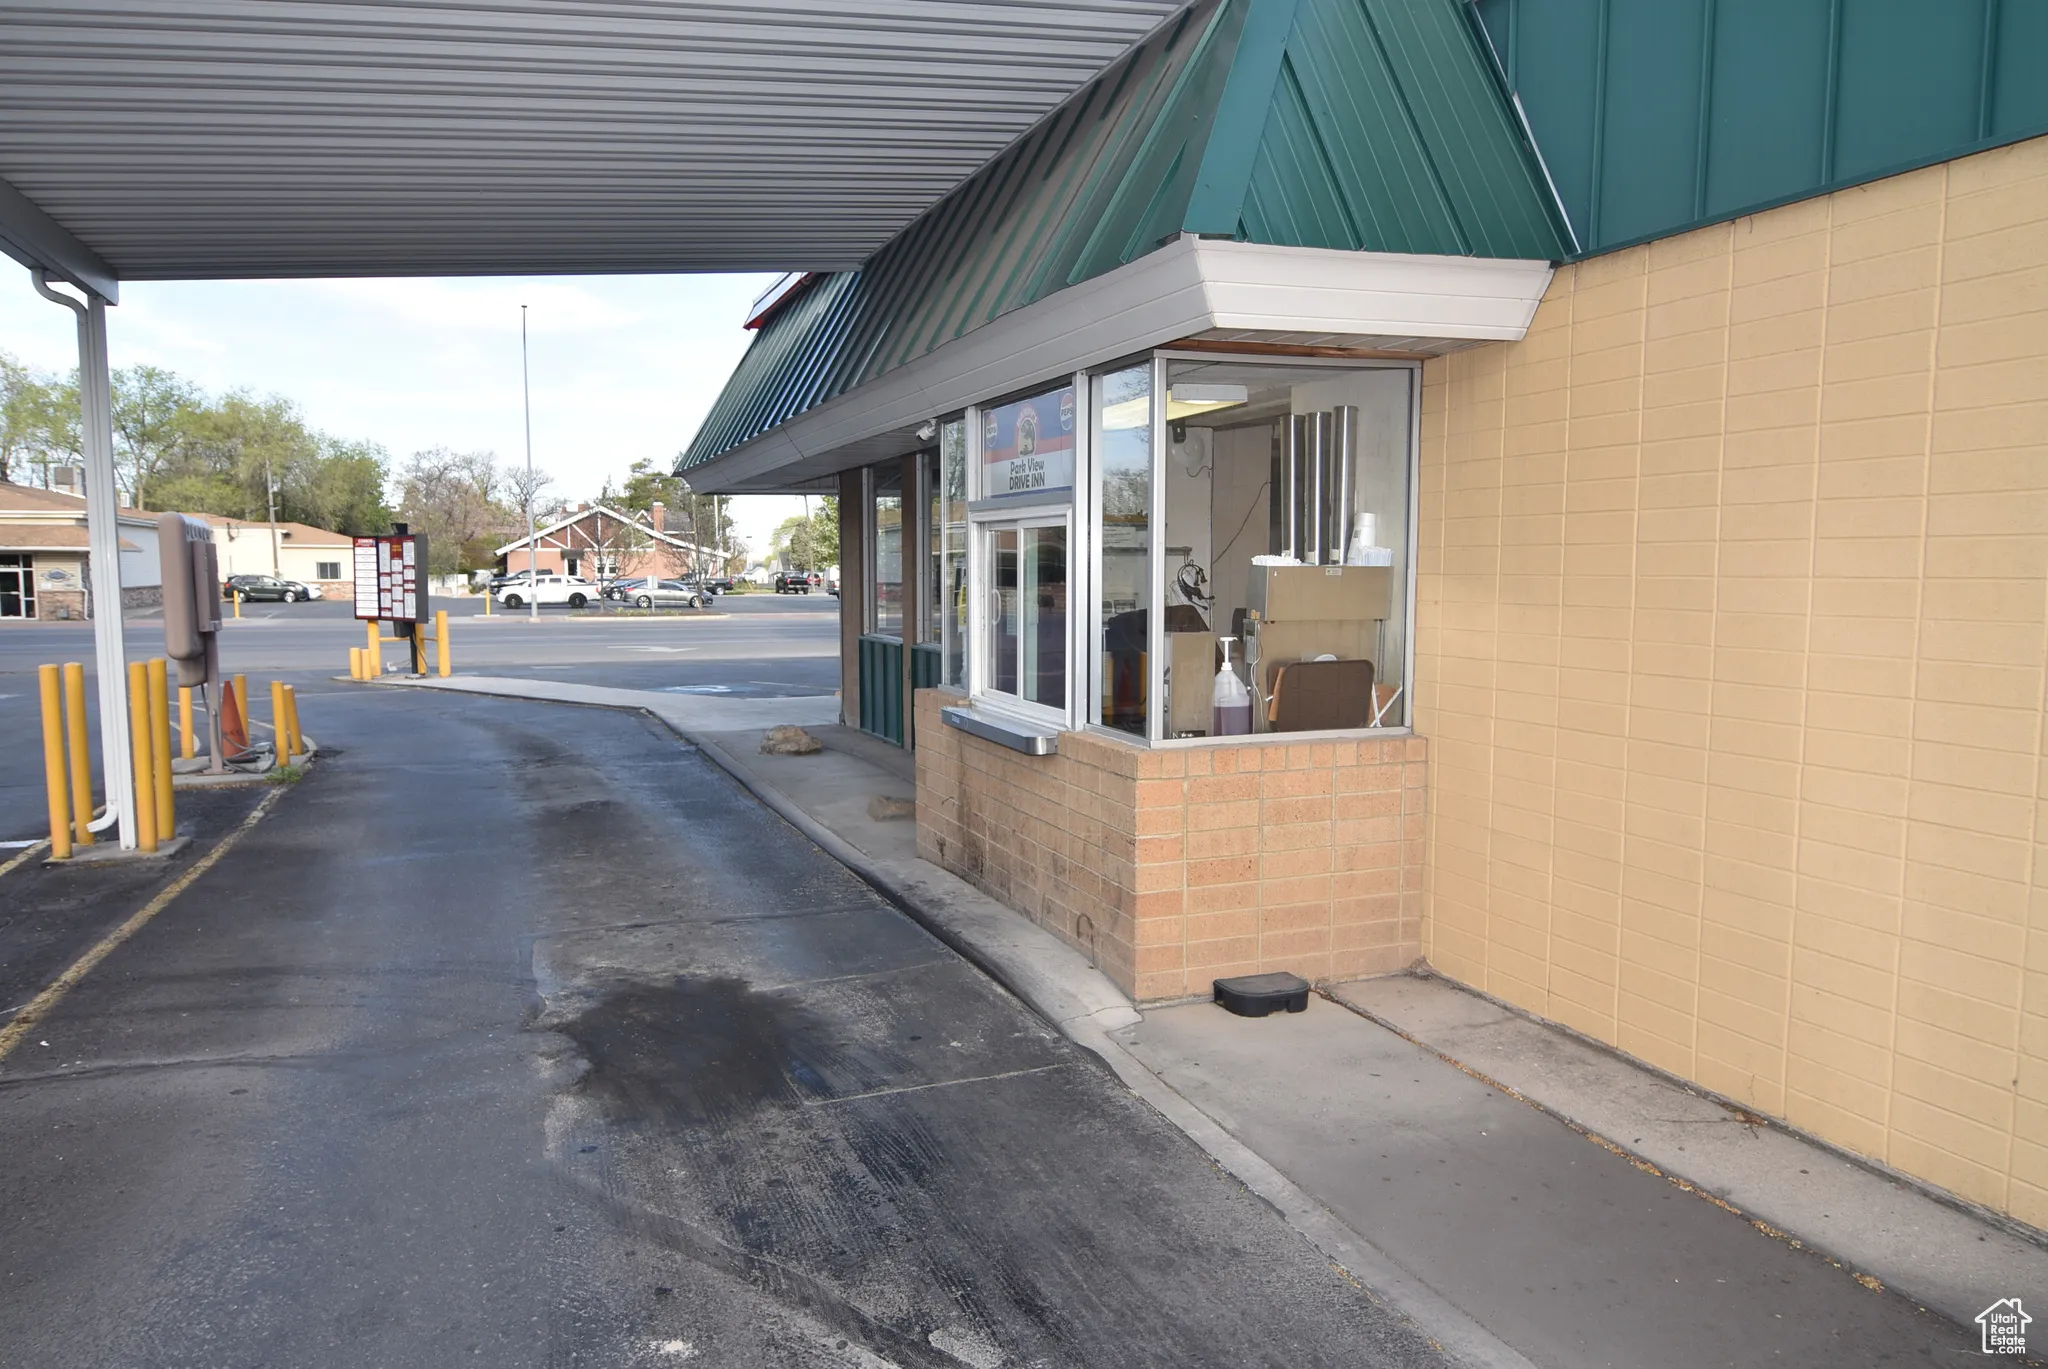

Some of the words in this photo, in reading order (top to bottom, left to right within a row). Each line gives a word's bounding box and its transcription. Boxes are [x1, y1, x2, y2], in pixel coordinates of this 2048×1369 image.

[1010, 459, 1026, 474] Park
[1028, 457, 1044, 471] View
[1009, 474, 1029, 490] DRIVE
[1031, 472, 1045, 487] INN
